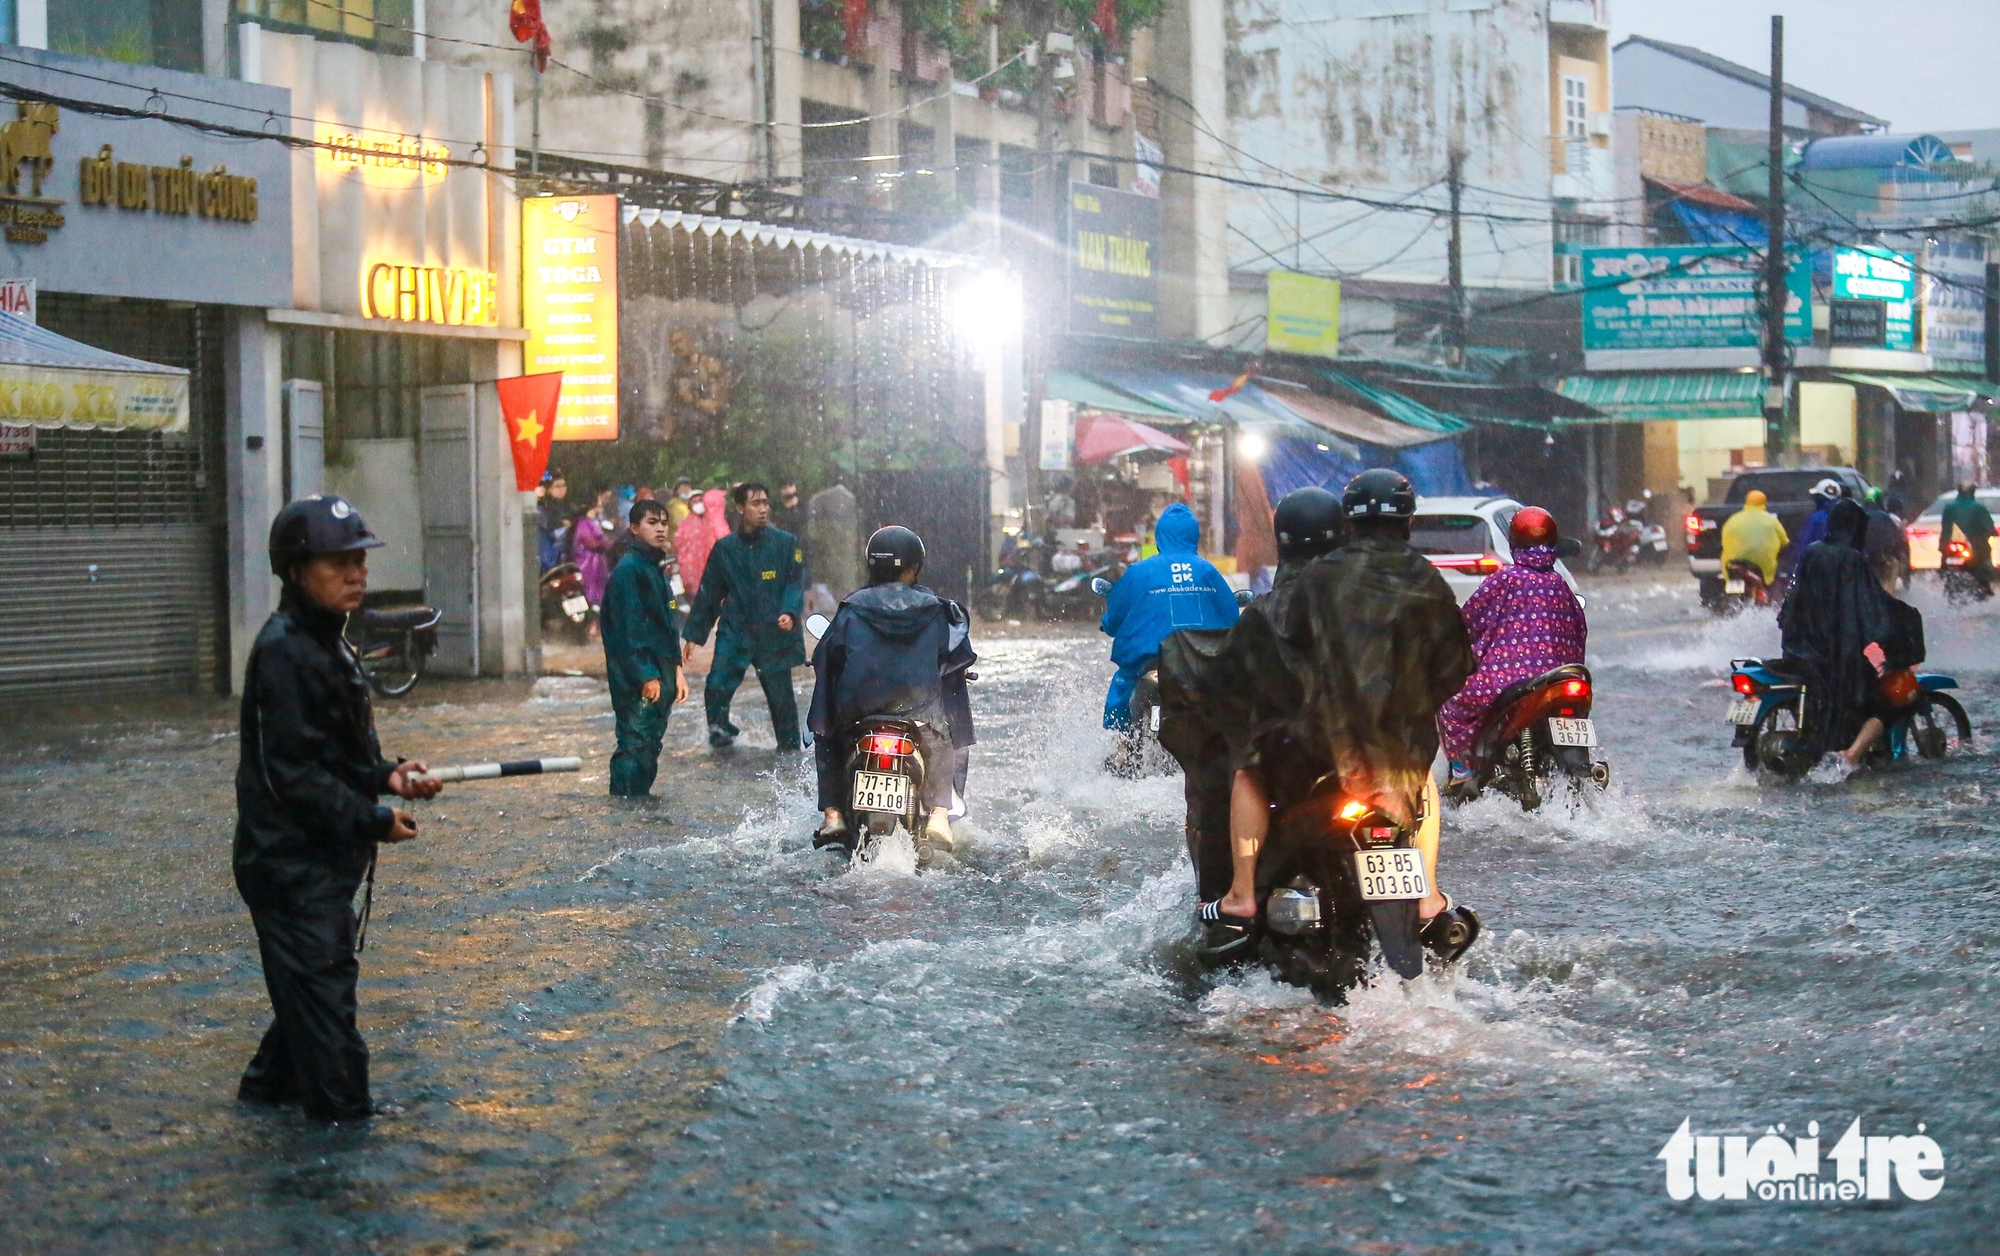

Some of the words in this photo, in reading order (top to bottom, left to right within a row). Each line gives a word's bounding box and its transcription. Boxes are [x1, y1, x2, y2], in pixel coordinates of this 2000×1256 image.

[543, 237, 596, 255] GYM
[538, 265, 602, 284] YOGA
[544, 334, 597, 344] AEROBIC
[536, 355, 568, 365] BODY
[569, 354, 605, 364] PUMP
[574, 394, 616, 405] DANCE
[567, 415, 608, 426] DANCE
[1170, 563, 1192, 573] OK
[1172, 573, 1194, 583] OK
[1556, 720, 1588, 732] 54-X8
[1559, 732, 1589, 744] 3677
[864, 775, 899, 792] 77-F1
[858, 791, 903, 809] 281.08
[1366, 854, 1413, 873] 63-B5
[1364, 875, 1424, 895] 303.60
